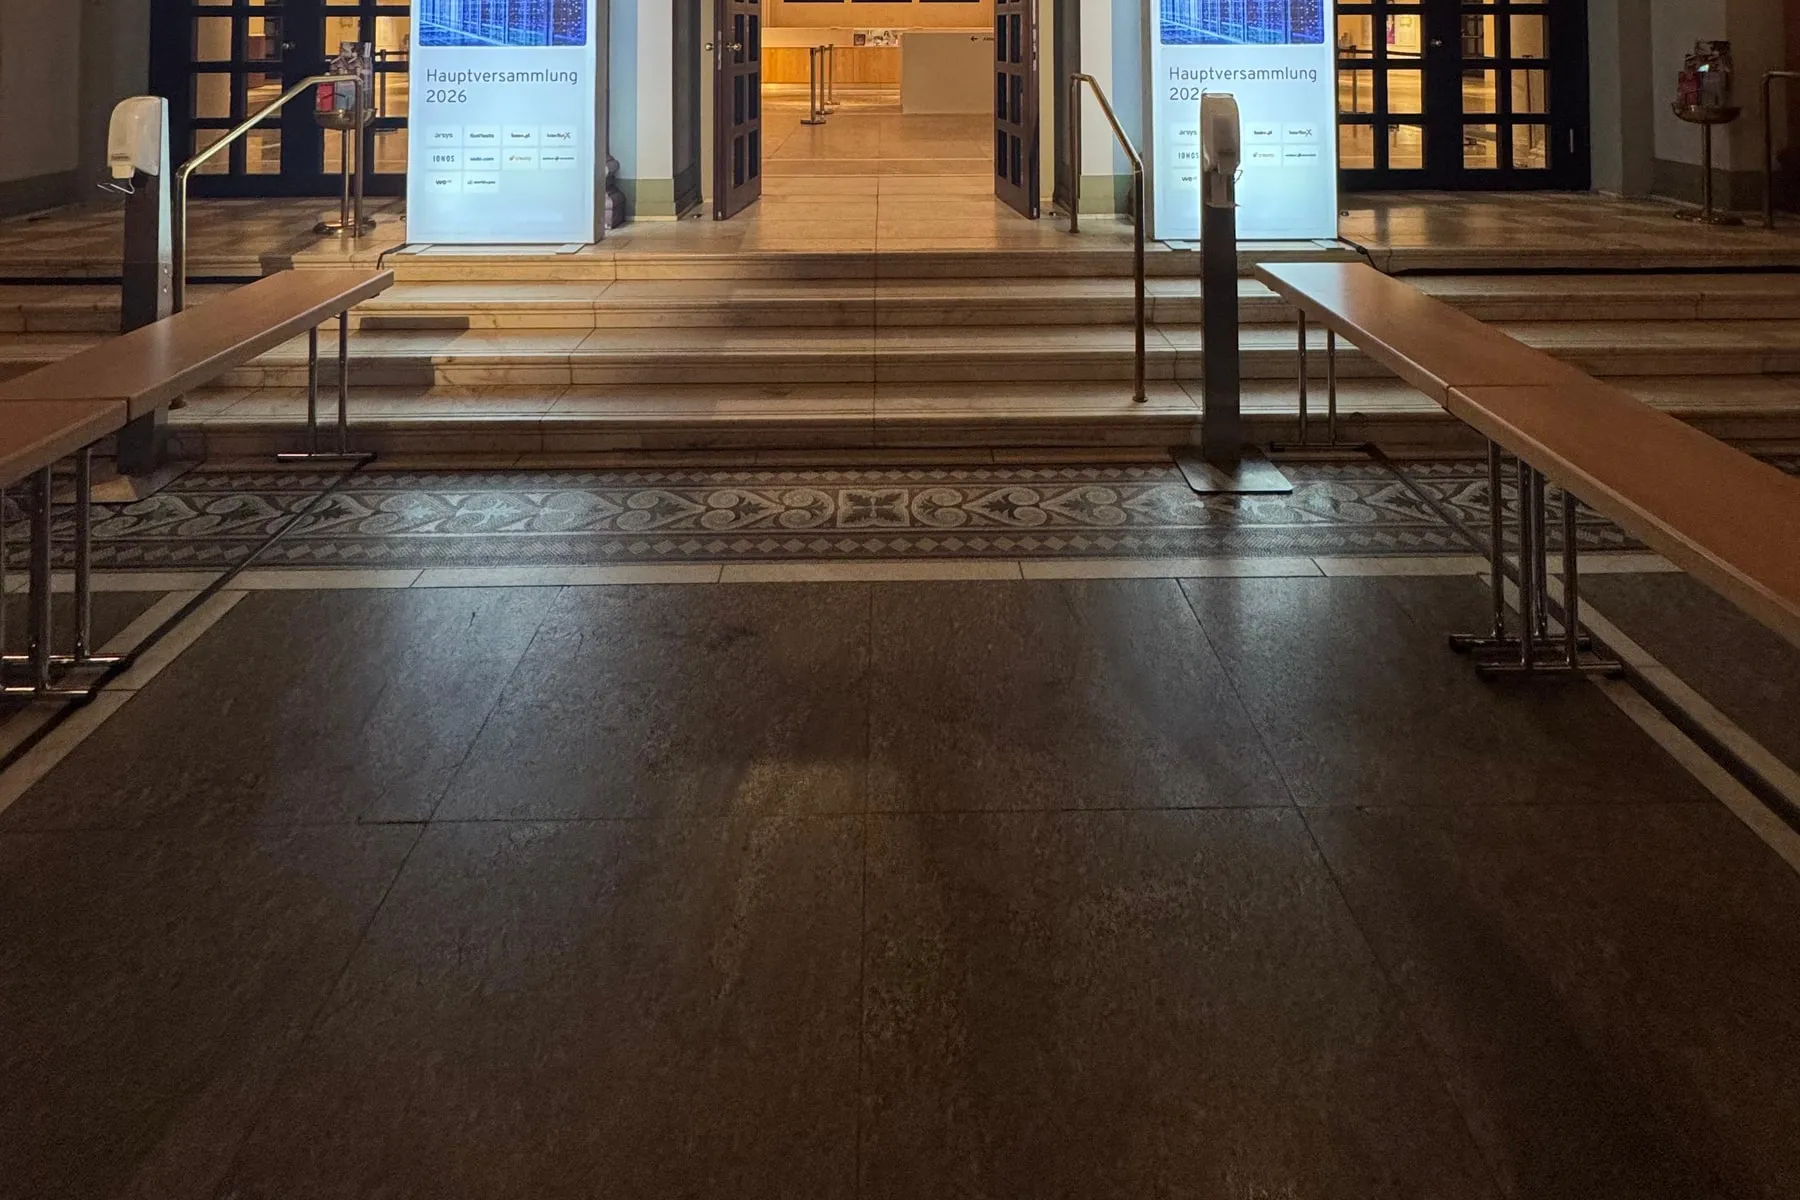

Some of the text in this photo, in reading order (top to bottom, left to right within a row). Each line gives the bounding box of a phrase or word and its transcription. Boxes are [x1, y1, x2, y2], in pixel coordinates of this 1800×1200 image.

[426, 68, 579, 86] Hauptversammlung
[1169, 66, 1318, 84] Hauptversammlung
[425, 89, 468, 103] 2026
[432, 155, 455, 163] IONOS
